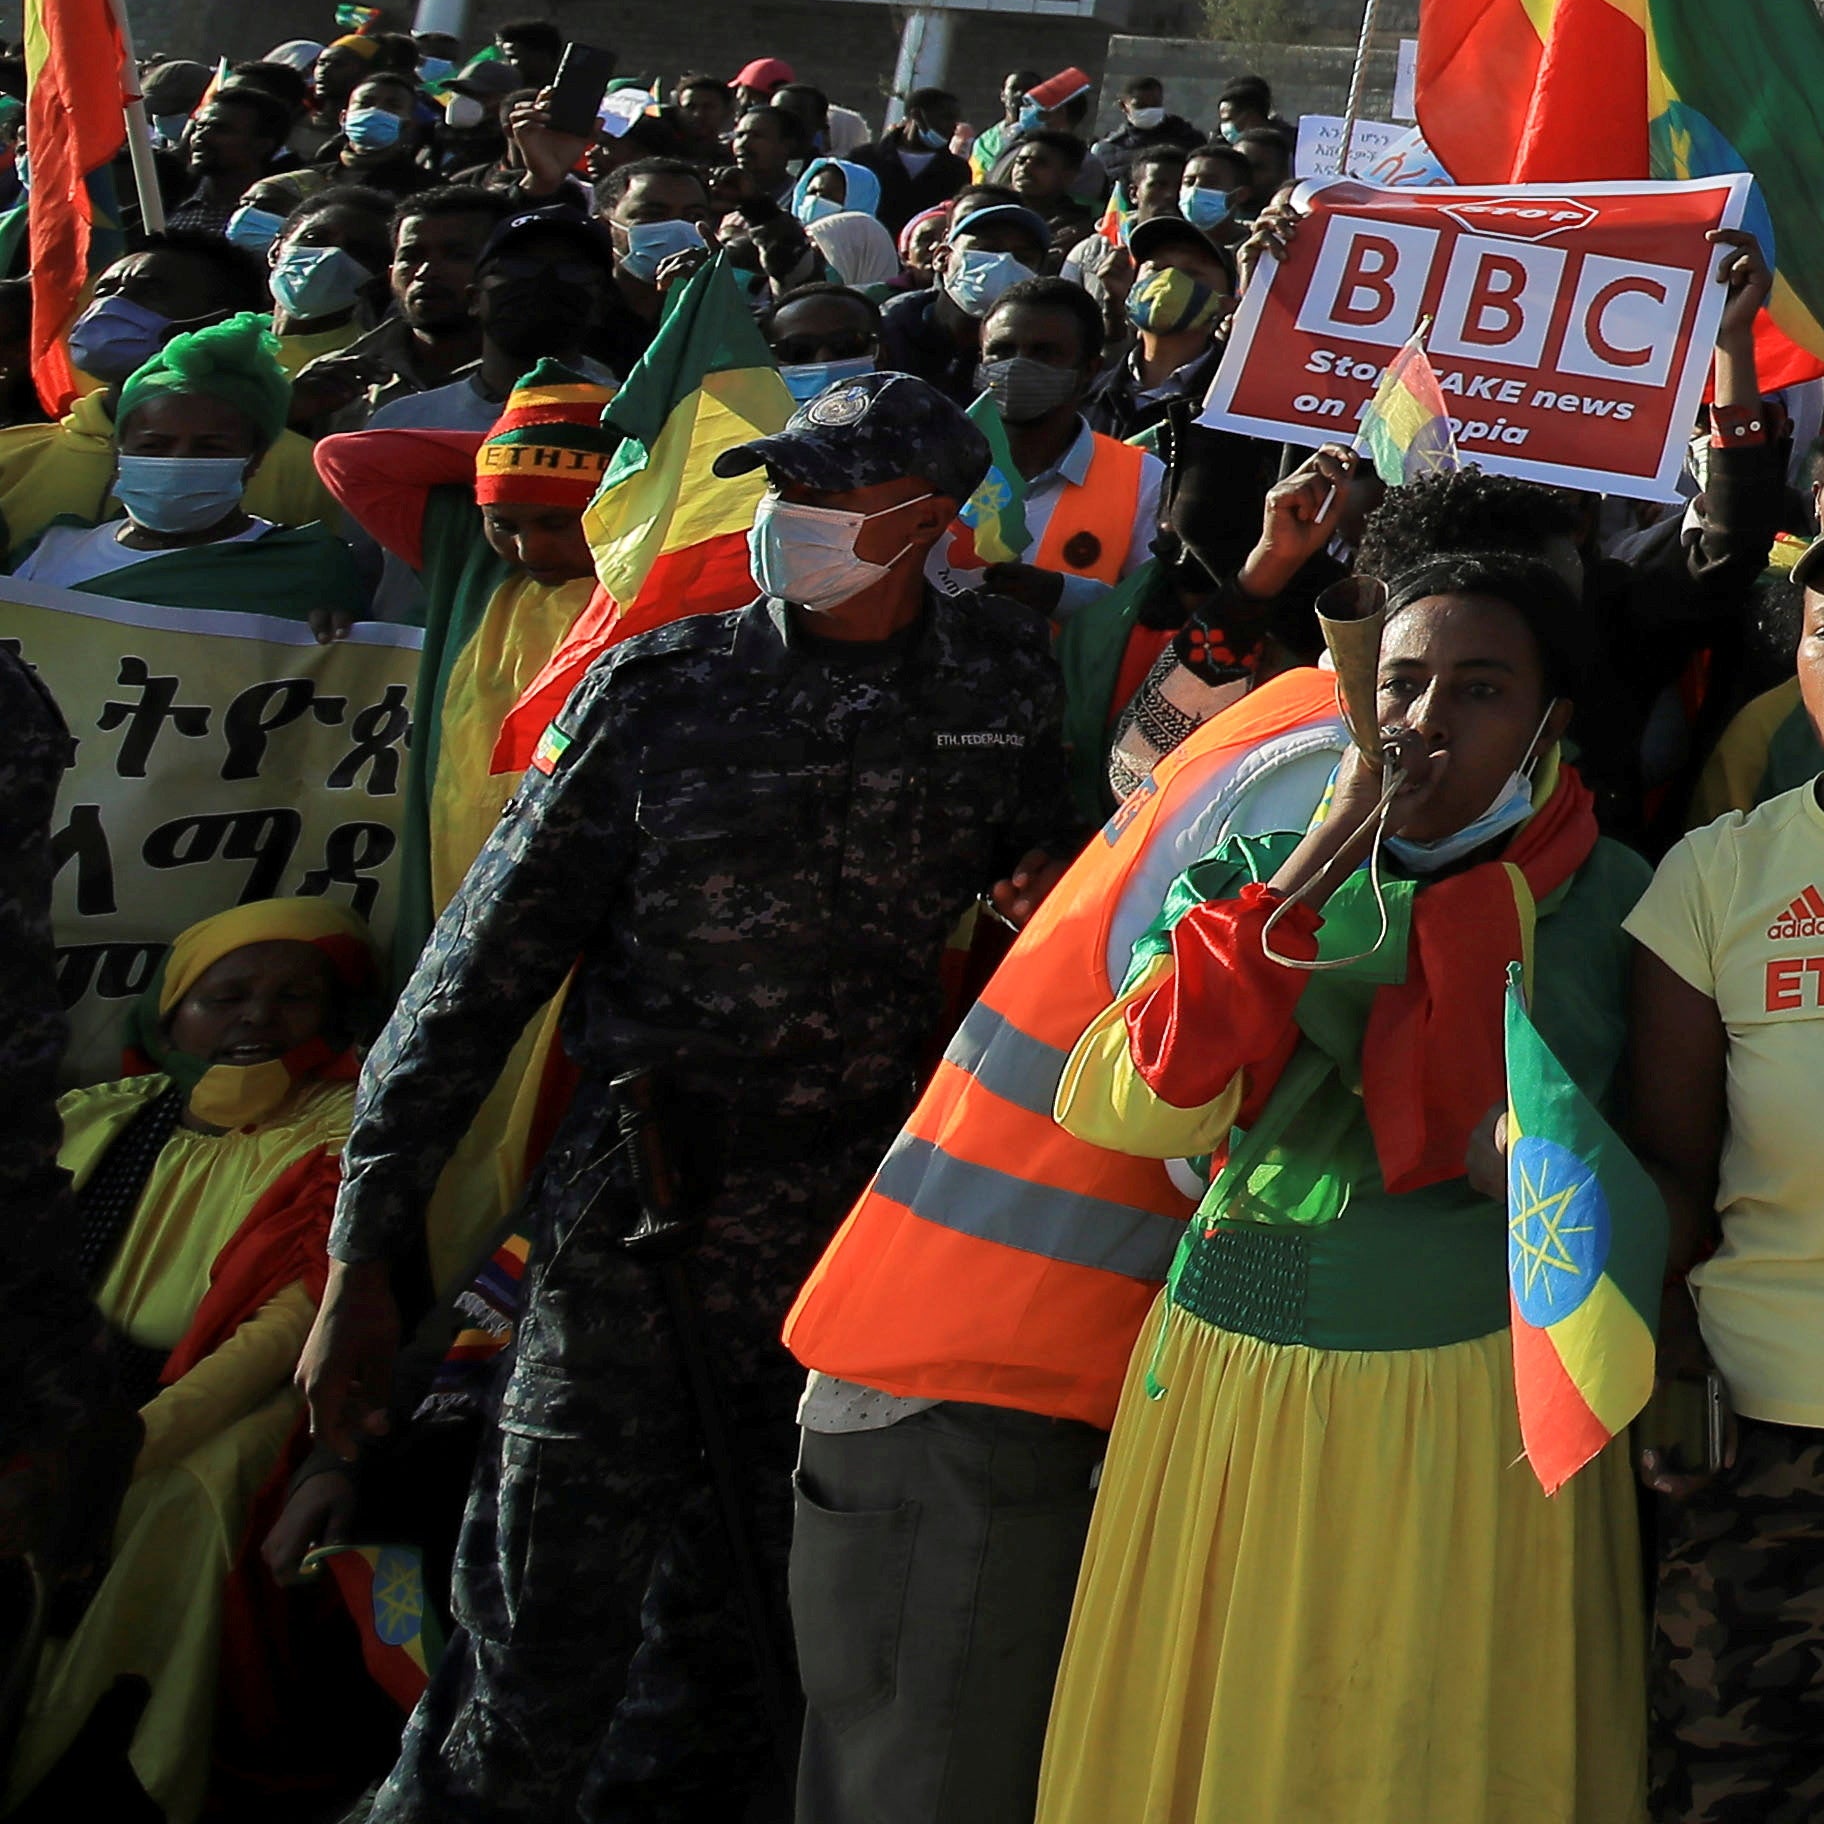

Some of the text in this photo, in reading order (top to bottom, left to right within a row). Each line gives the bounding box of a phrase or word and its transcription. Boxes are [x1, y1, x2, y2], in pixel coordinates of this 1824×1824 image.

[1459, 205, 1584, 222] STOP
[1328, 233, 1667, 368] BBC
[1293, 394, 1346, 417] on
[1530, 389, 1635, 421] news
[937, 734, 960, 746] ETH.
[961, 733, 1005, 745] FEDERAL
